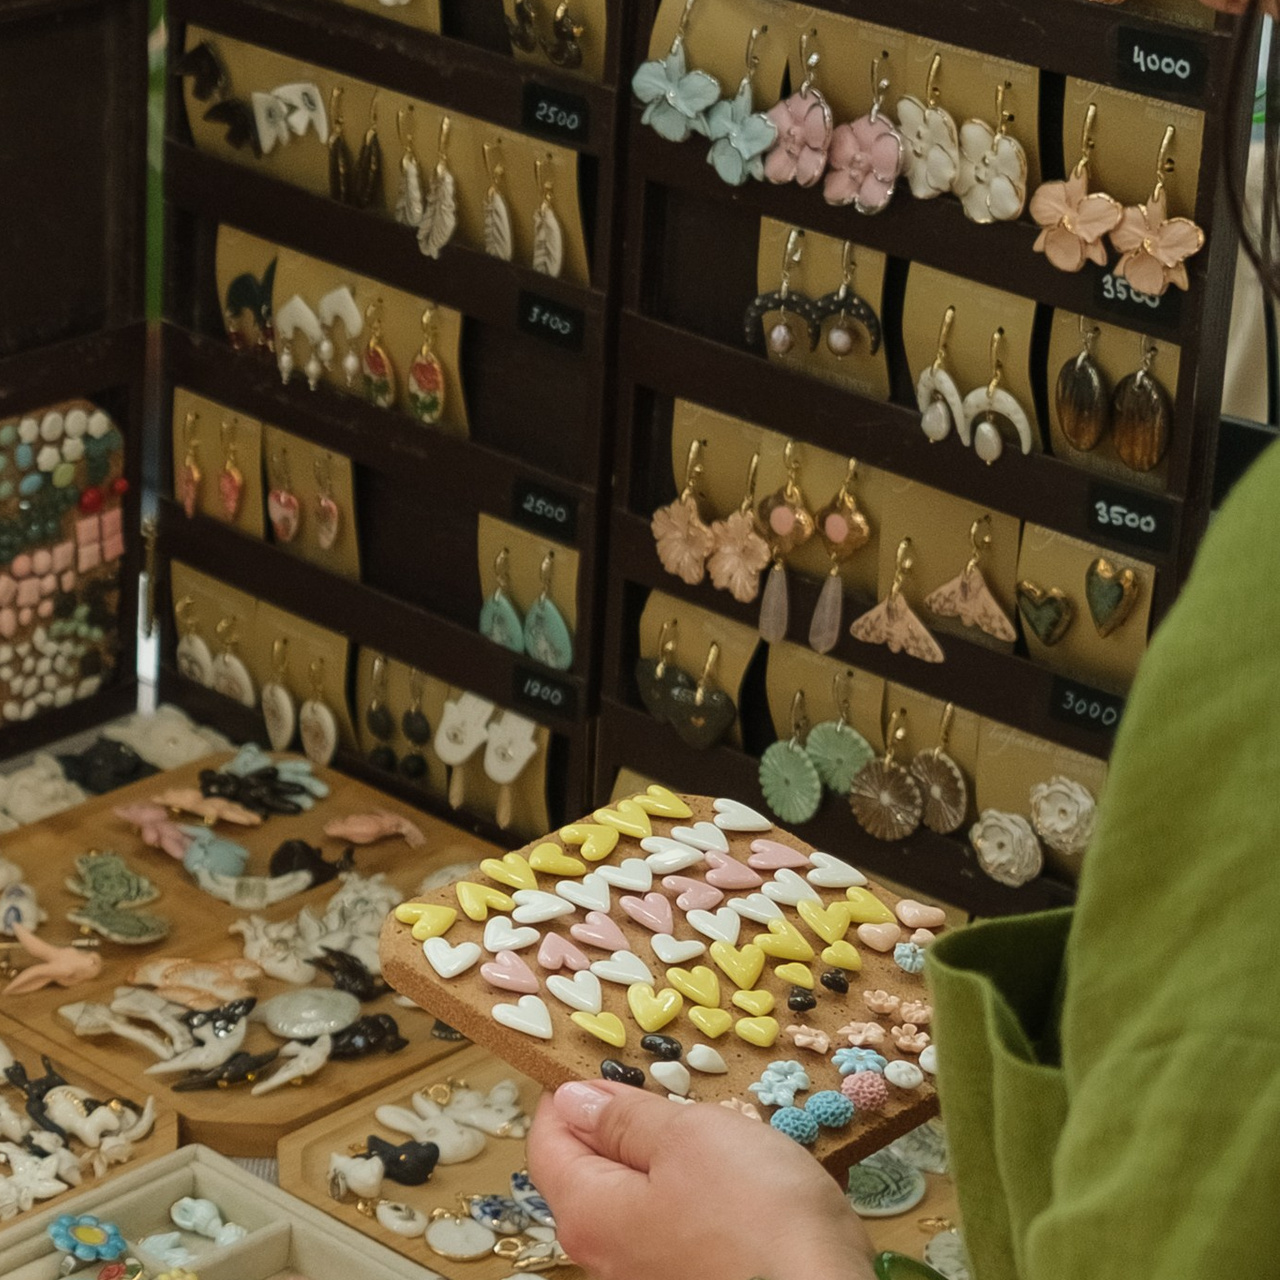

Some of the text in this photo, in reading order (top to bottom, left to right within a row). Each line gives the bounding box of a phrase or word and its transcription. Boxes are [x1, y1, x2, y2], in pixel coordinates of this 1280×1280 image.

[1132, 48, 1192, 79] 4000
[535, 101, 580, 130] 2500
[1095, 500, 1157, 534] 3500
[1061, 690, 1117, 726] 3000
